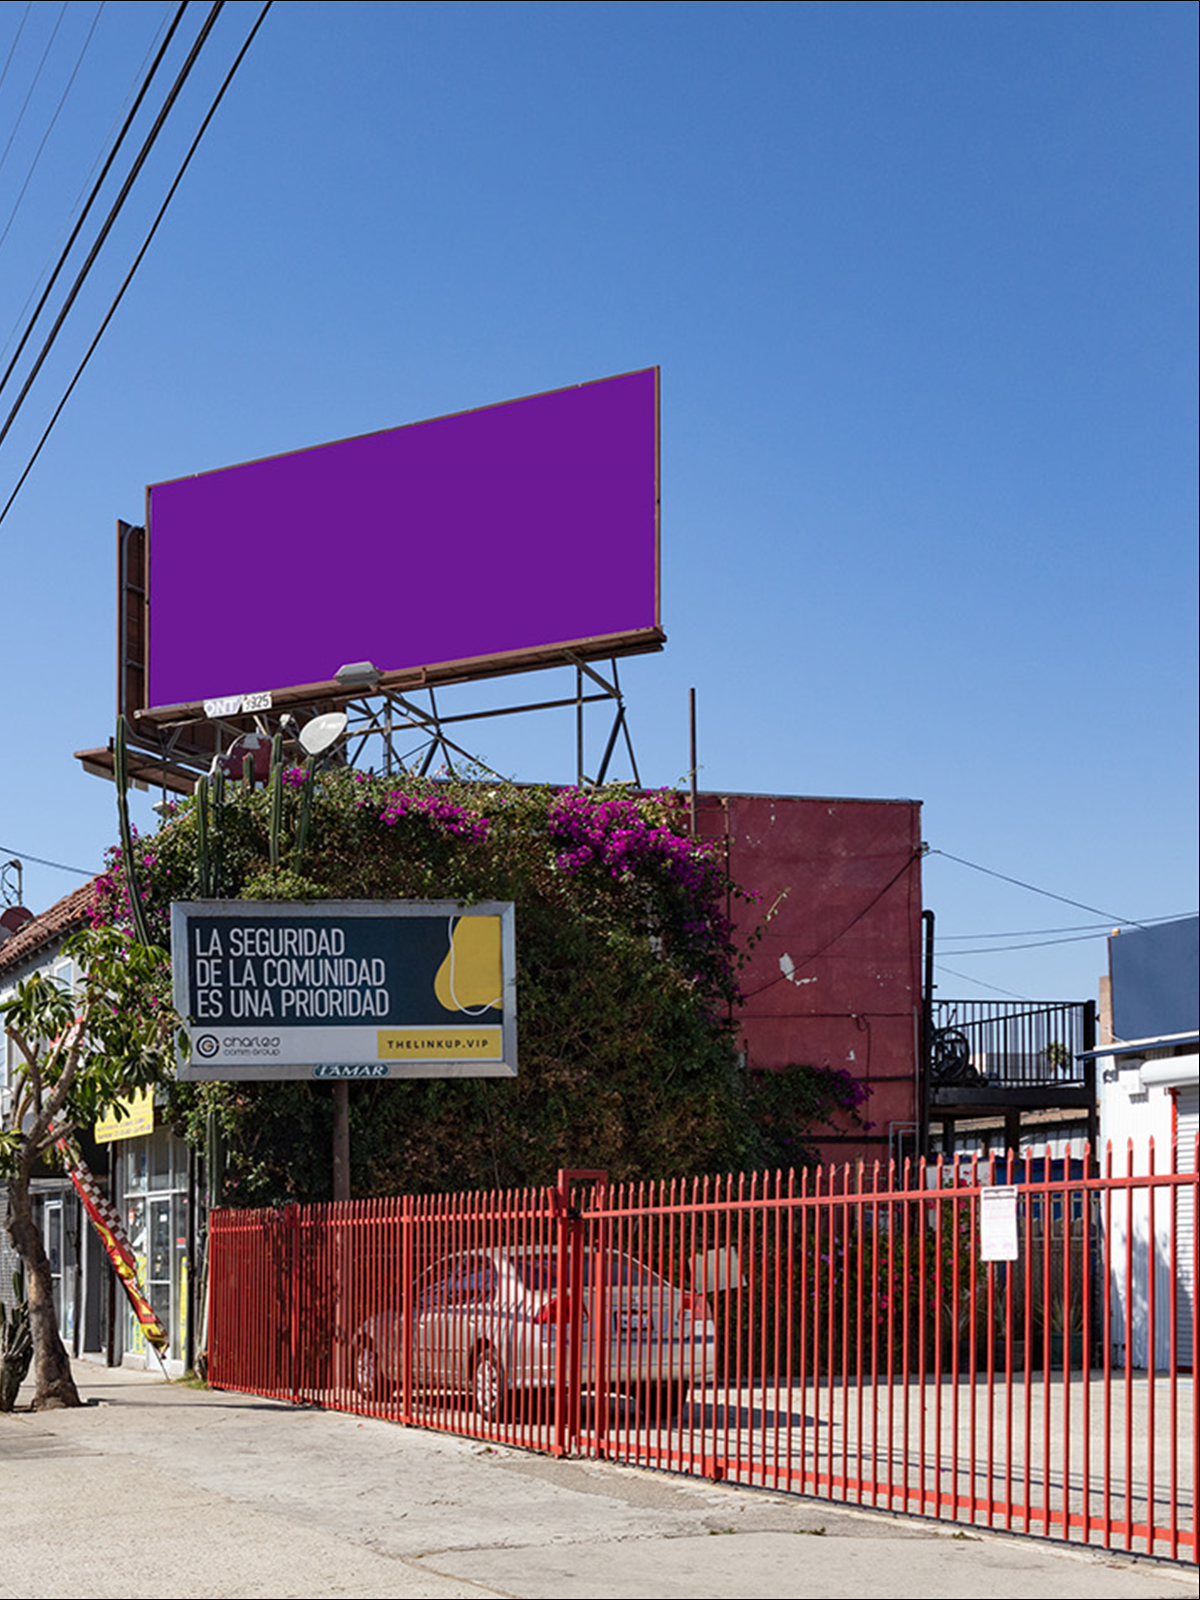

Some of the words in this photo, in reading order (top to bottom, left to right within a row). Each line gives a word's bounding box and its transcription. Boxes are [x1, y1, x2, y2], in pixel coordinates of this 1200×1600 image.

[196, 928, 223, 956] LA
[229, 928, 345, 956] SEGURIDAD
[196, 959, 222, 987] DE
[229, 959, 257, 987] LA
[263, 958, 386, 987] COMUNIDAD
[197, 989, 223, 1018] ES
[230, 989, 275, 1018] UNA
[281, 988, 390, 1017] PRIORIDAD
[387, 1039, 489, 1049] THELINKUP.VIP
[319, 1064, 385, 1077] LAMAR
